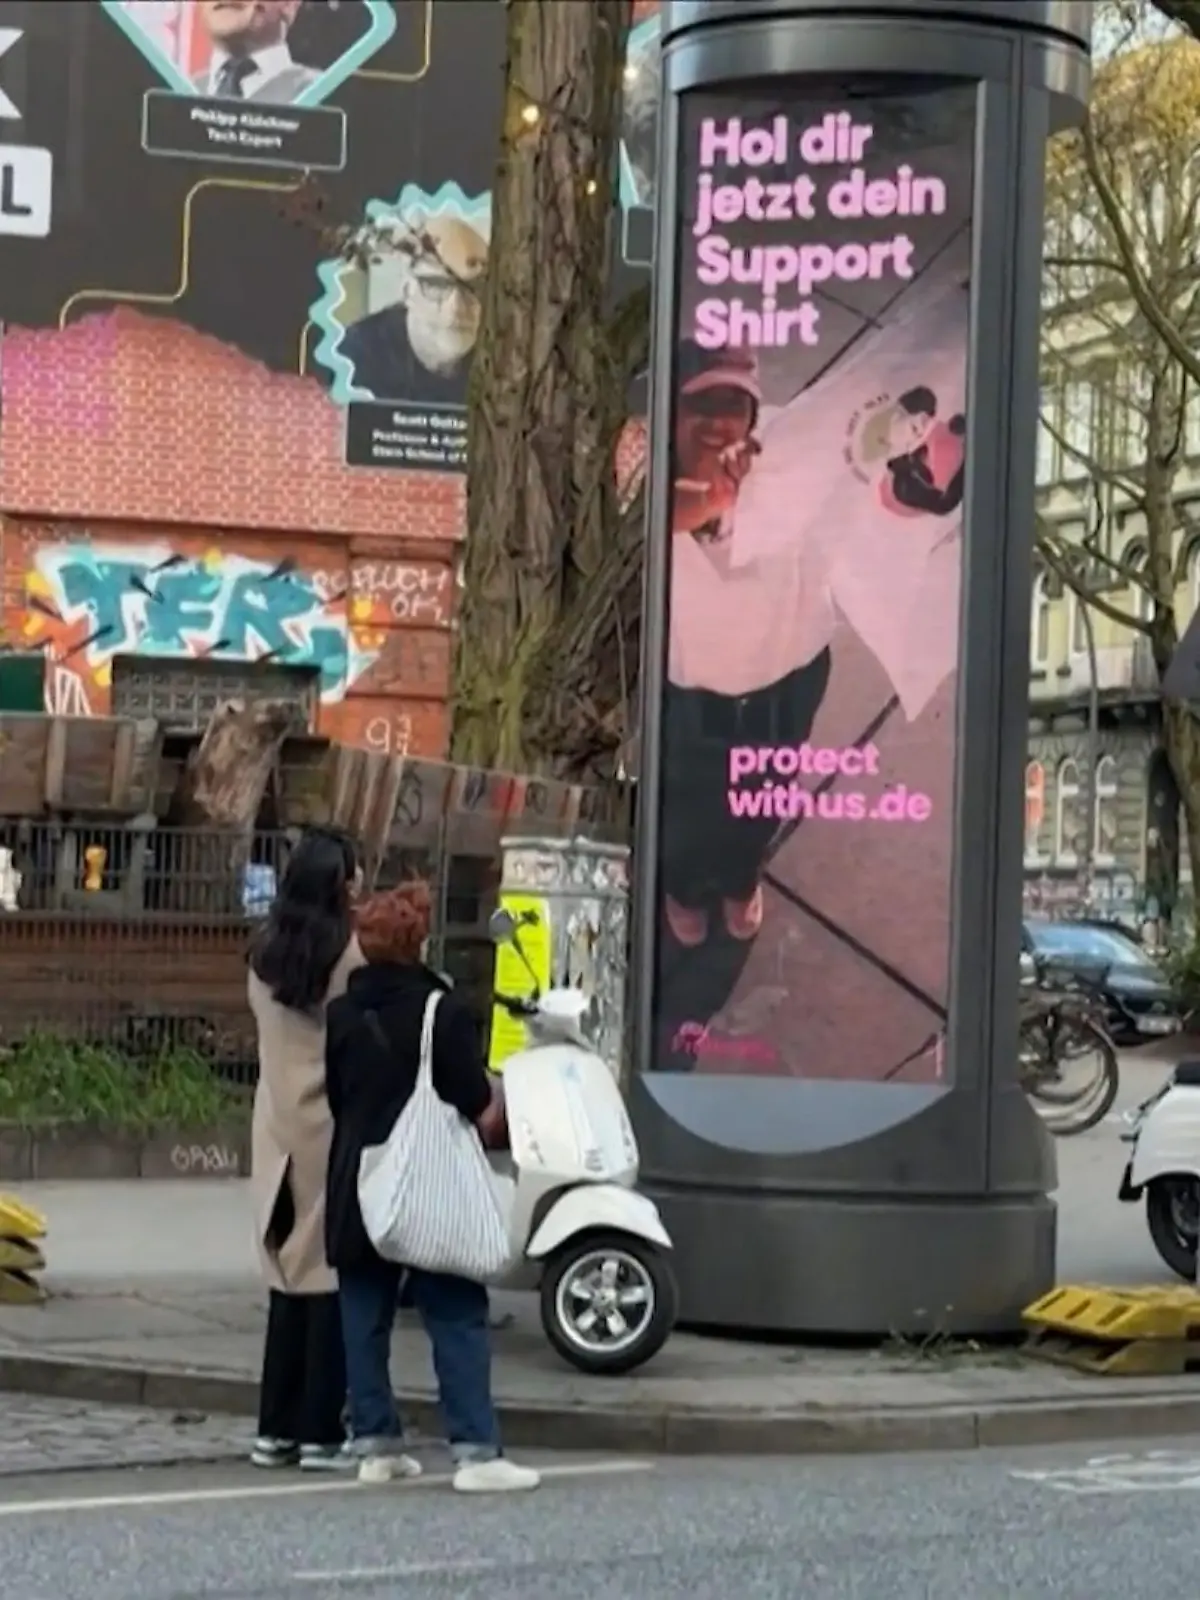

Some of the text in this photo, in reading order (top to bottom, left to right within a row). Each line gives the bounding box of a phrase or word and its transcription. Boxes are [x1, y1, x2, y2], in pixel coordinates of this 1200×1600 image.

[700, 111, 874, 167] Hol dir
[692, 164, 946, 236] jetzt dein
[697, 234, 915, 294] Support
[694, 298, 819, 349] Shirt
[729, 742, 880, 783] protect
[728, 779, 933, 821] withus.de
